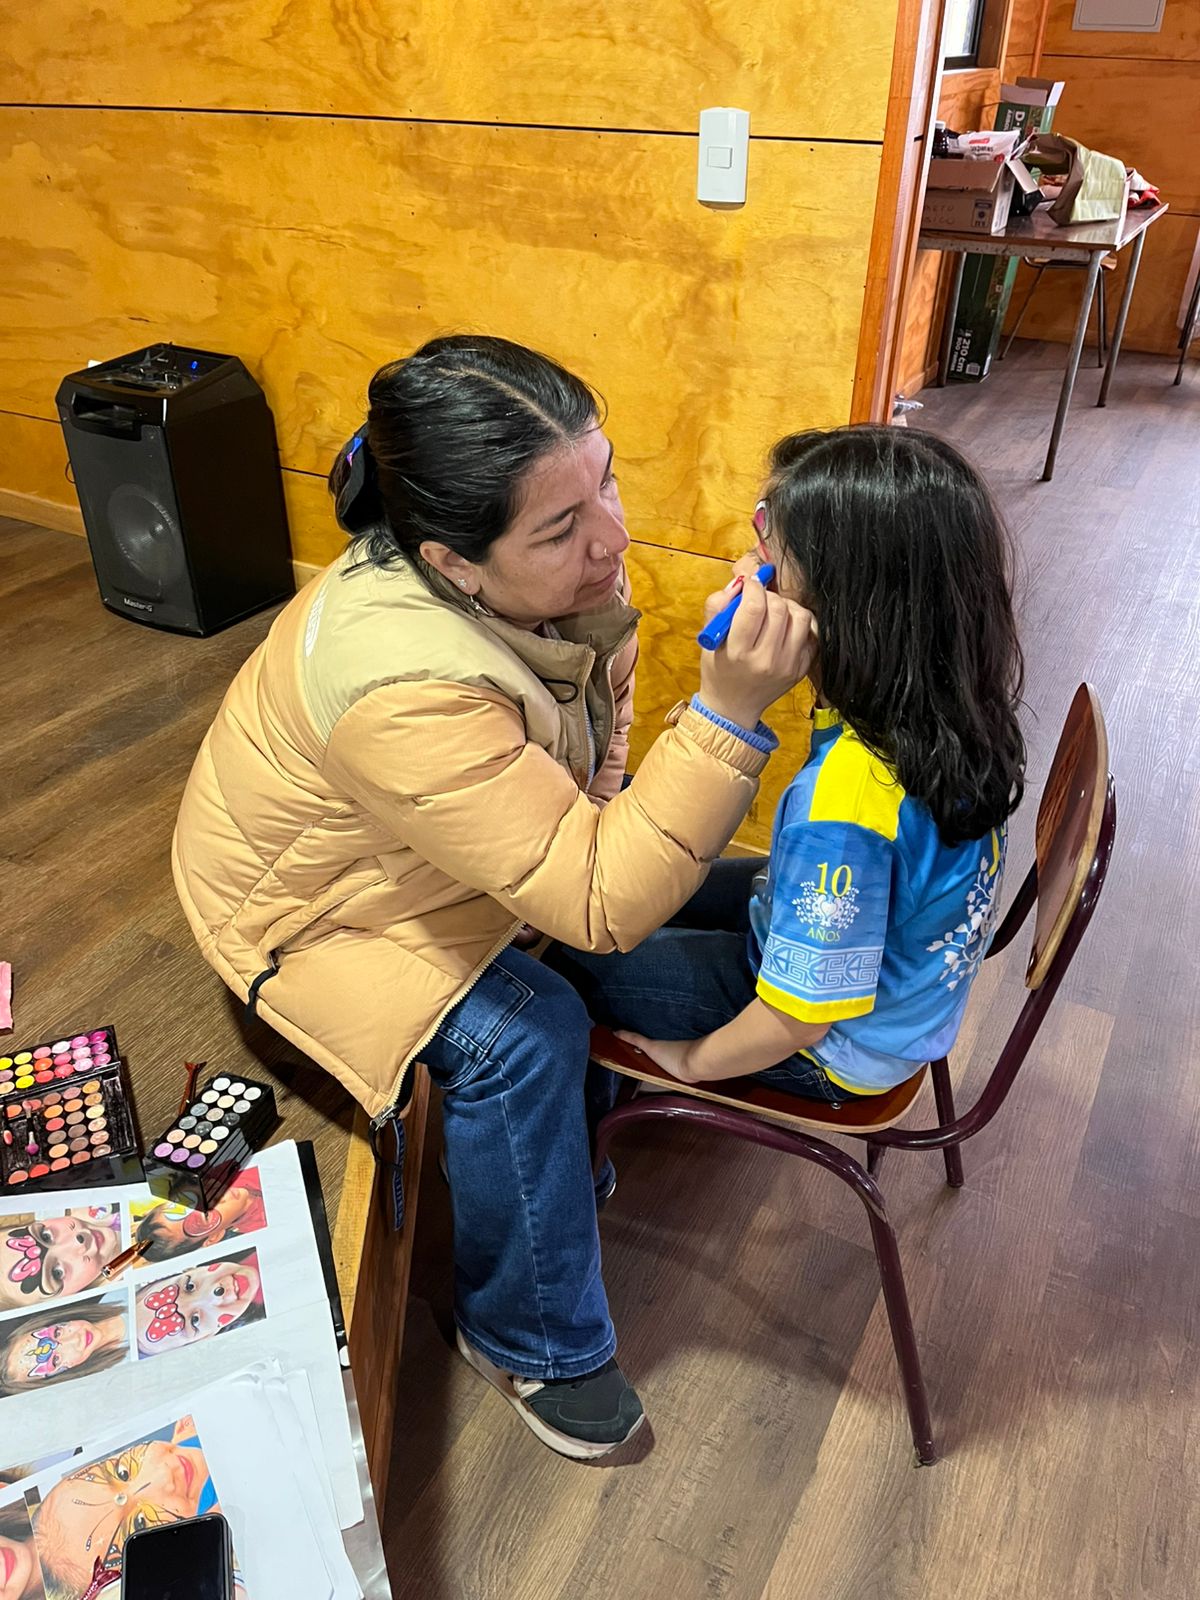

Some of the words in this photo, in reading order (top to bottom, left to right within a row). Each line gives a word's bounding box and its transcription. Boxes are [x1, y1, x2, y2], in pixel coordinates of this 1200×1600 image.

[961, 338, 971, 357] 210
[956, 357, 967, 372] cm
[813, 861, 853, 897] 10
[806, 926, 842, 942] AÑOS
